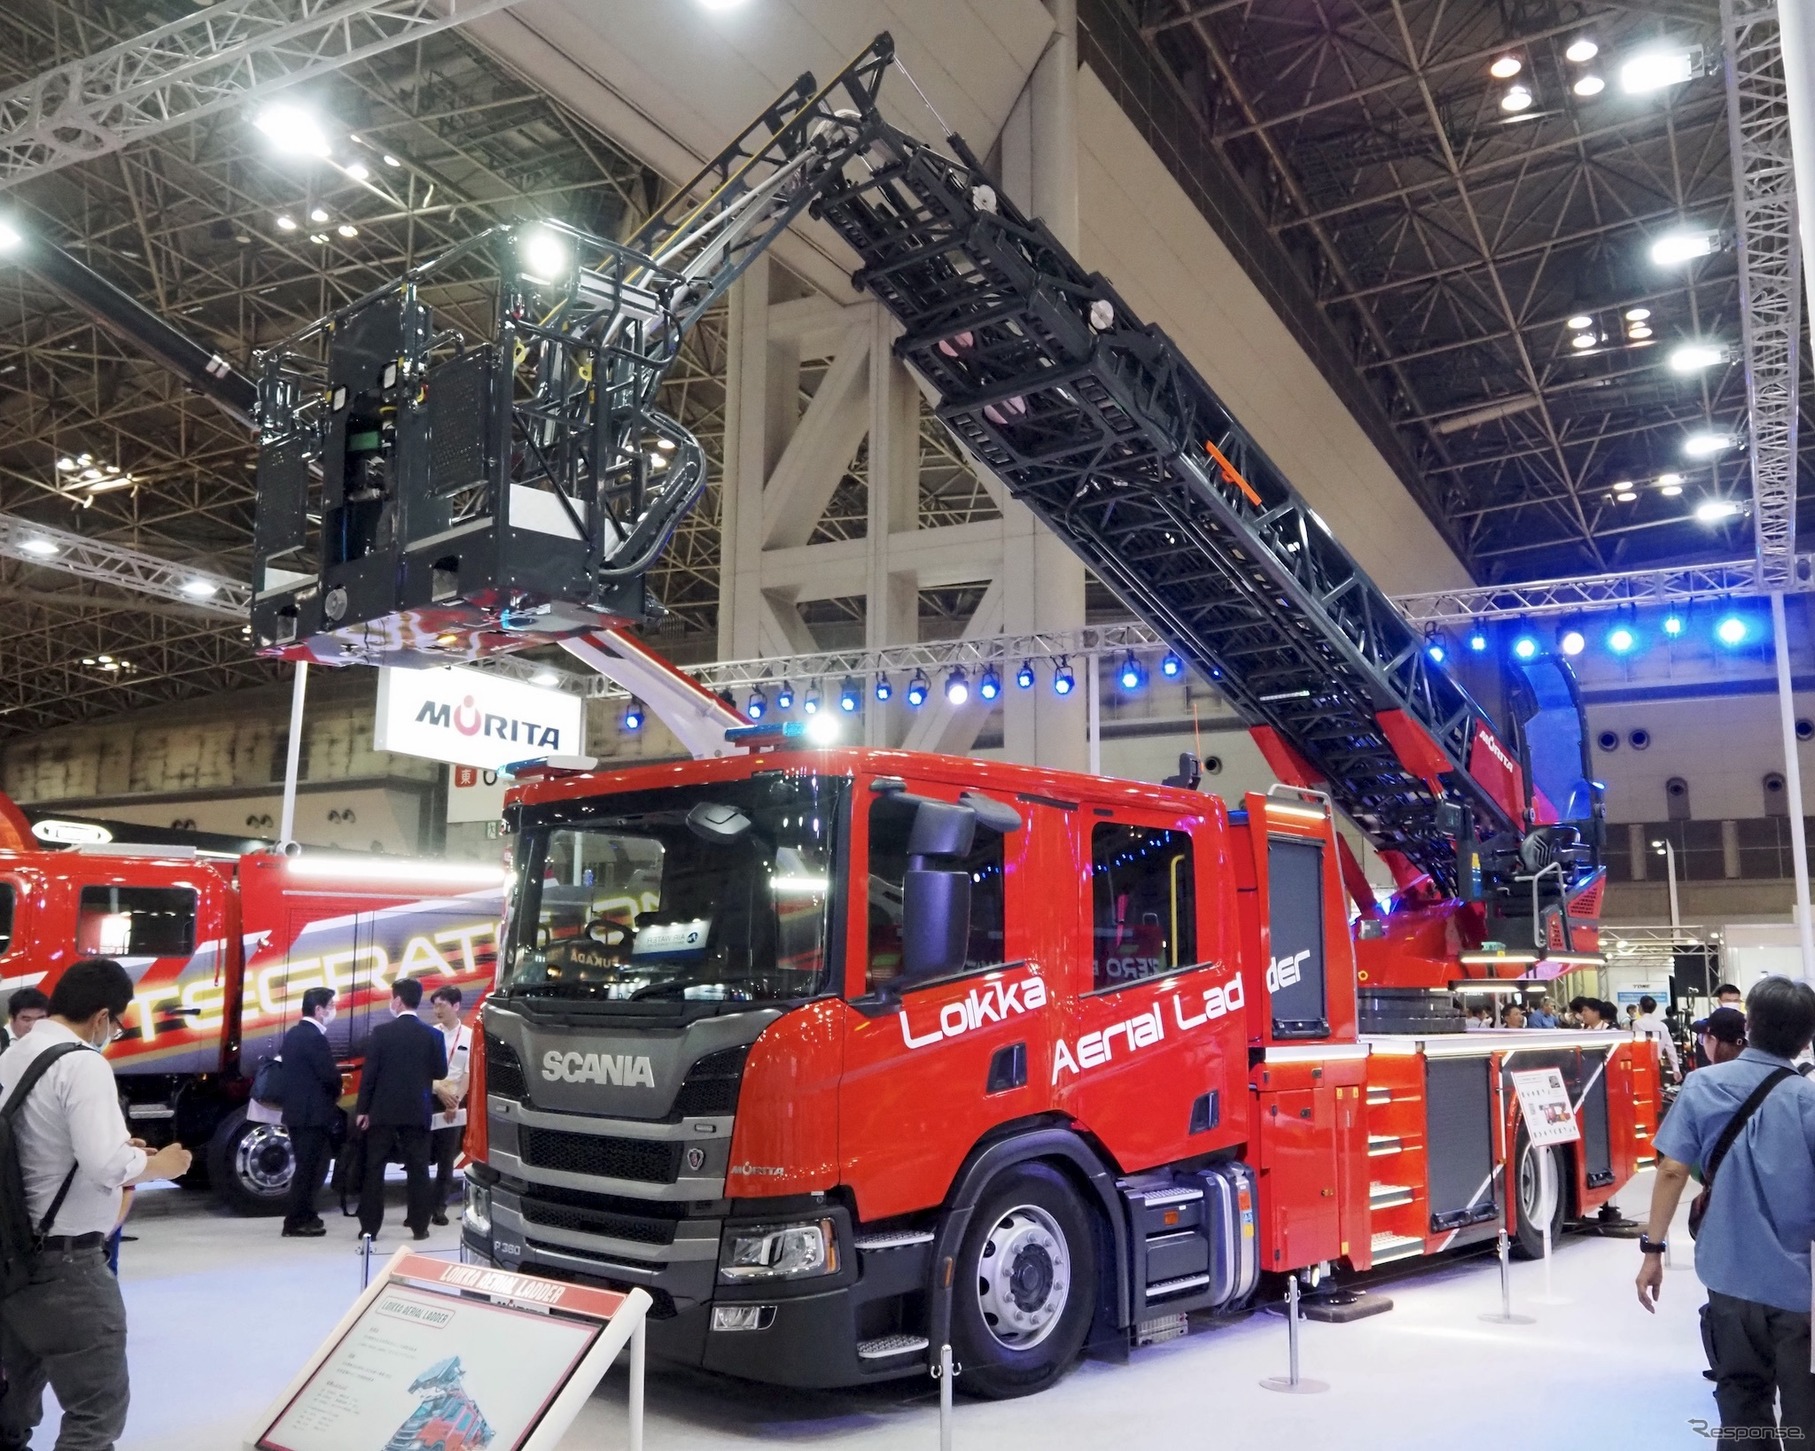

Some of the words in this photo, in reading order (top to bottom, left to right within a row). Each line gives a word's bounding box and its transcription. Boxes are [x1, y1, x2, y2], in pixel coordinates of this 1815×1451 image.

[415, 695, 560, 750] MORITA
[129, 921, 505, 1043] TEGRAT
[541, 1050, 655, 1088] SCANIA
[1052, 1002, 1164, 1086] Aerial
[514, 1279, 566, 1304] LADDER
